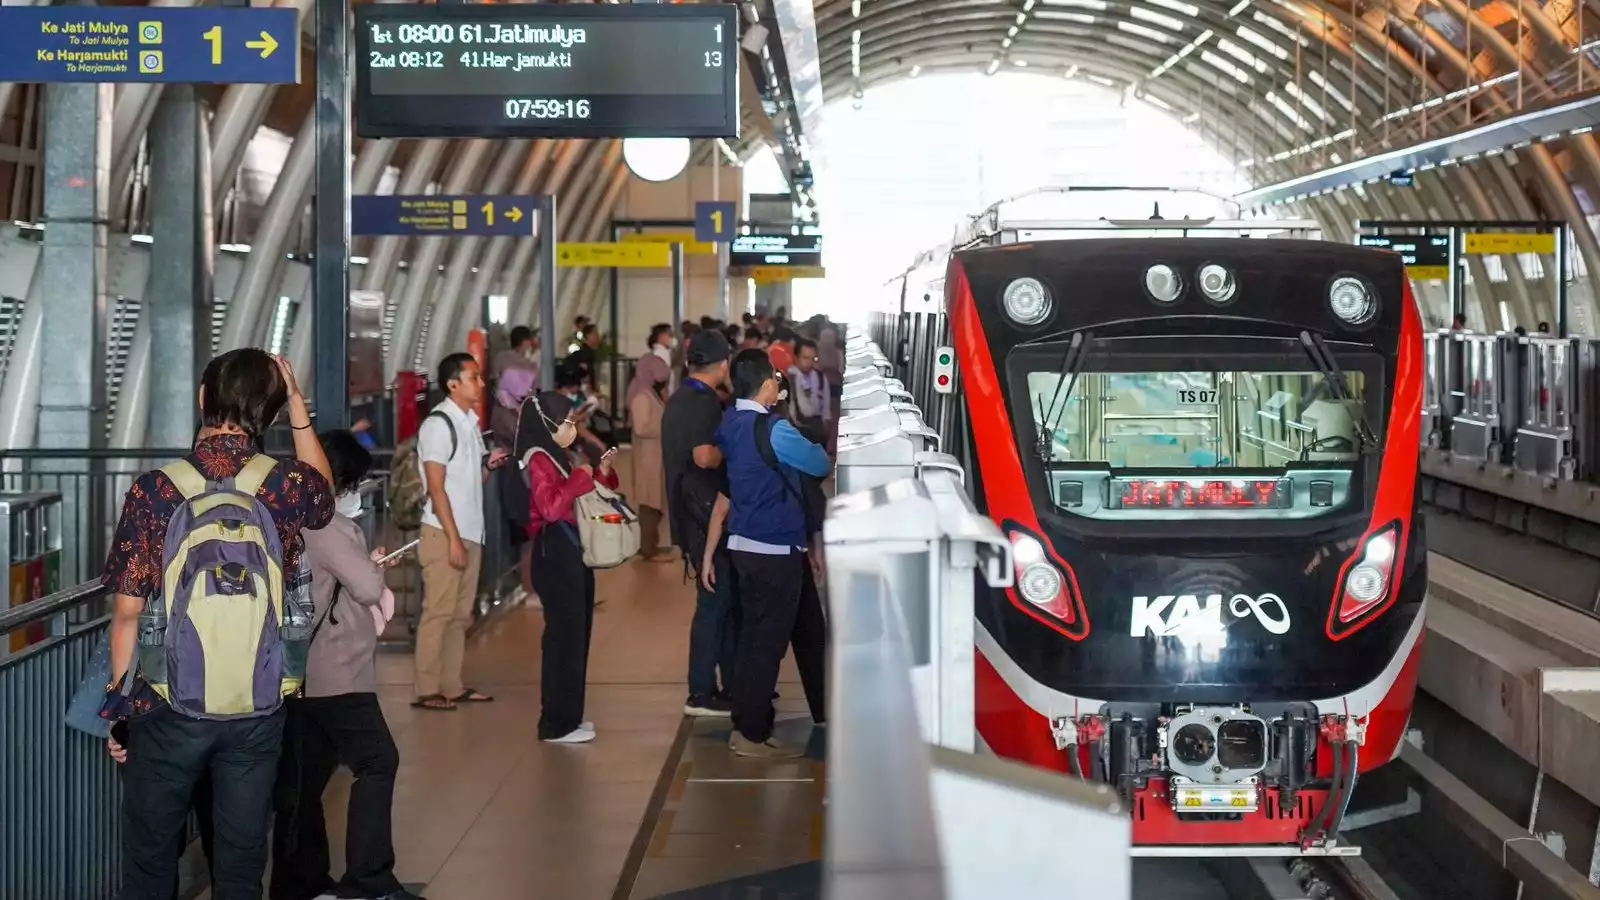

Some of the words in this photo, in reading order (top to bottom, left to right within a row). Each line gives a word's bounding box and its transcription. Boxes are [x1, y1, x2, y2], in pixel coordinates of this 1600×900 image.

[42, 22, 58, 33] Ke
[61, 22, 86, 34] Jati
[89, 22, 128, 35] Mulya
[371, 24, 393, 44] 1st
[398, 24, 454, 44] 08:00
[459, 24, 586, 48] 61.Jatimulya
[714, 25, 723, 43] 1
[69, 36, 80, 45] To
[82, 36, 99, 45] Jati
[102, 36, 129, 46] Mulya
[203, 25, 222, 65] 1
[38, 50, 54, 61] Ke
[57, 49, 128, 63] Harjamukti
[370, 52, 396, 68] 2nd
[399, 52, 444, 68] 08:12
[704, 52, 722, 68] 13
[67, 64, 77, 72] To
[78, 63, 127, 73] Harjamukti
[505, 98, 590, 119] 07:59:16
[481, 201, 495, 226] 1
[710, 211, 723, 233] 1
[1179, 391, 1197, 403] TS
[1199, 391, 1217, 403] 07
[1130, 594, 1223, 638] KAI
